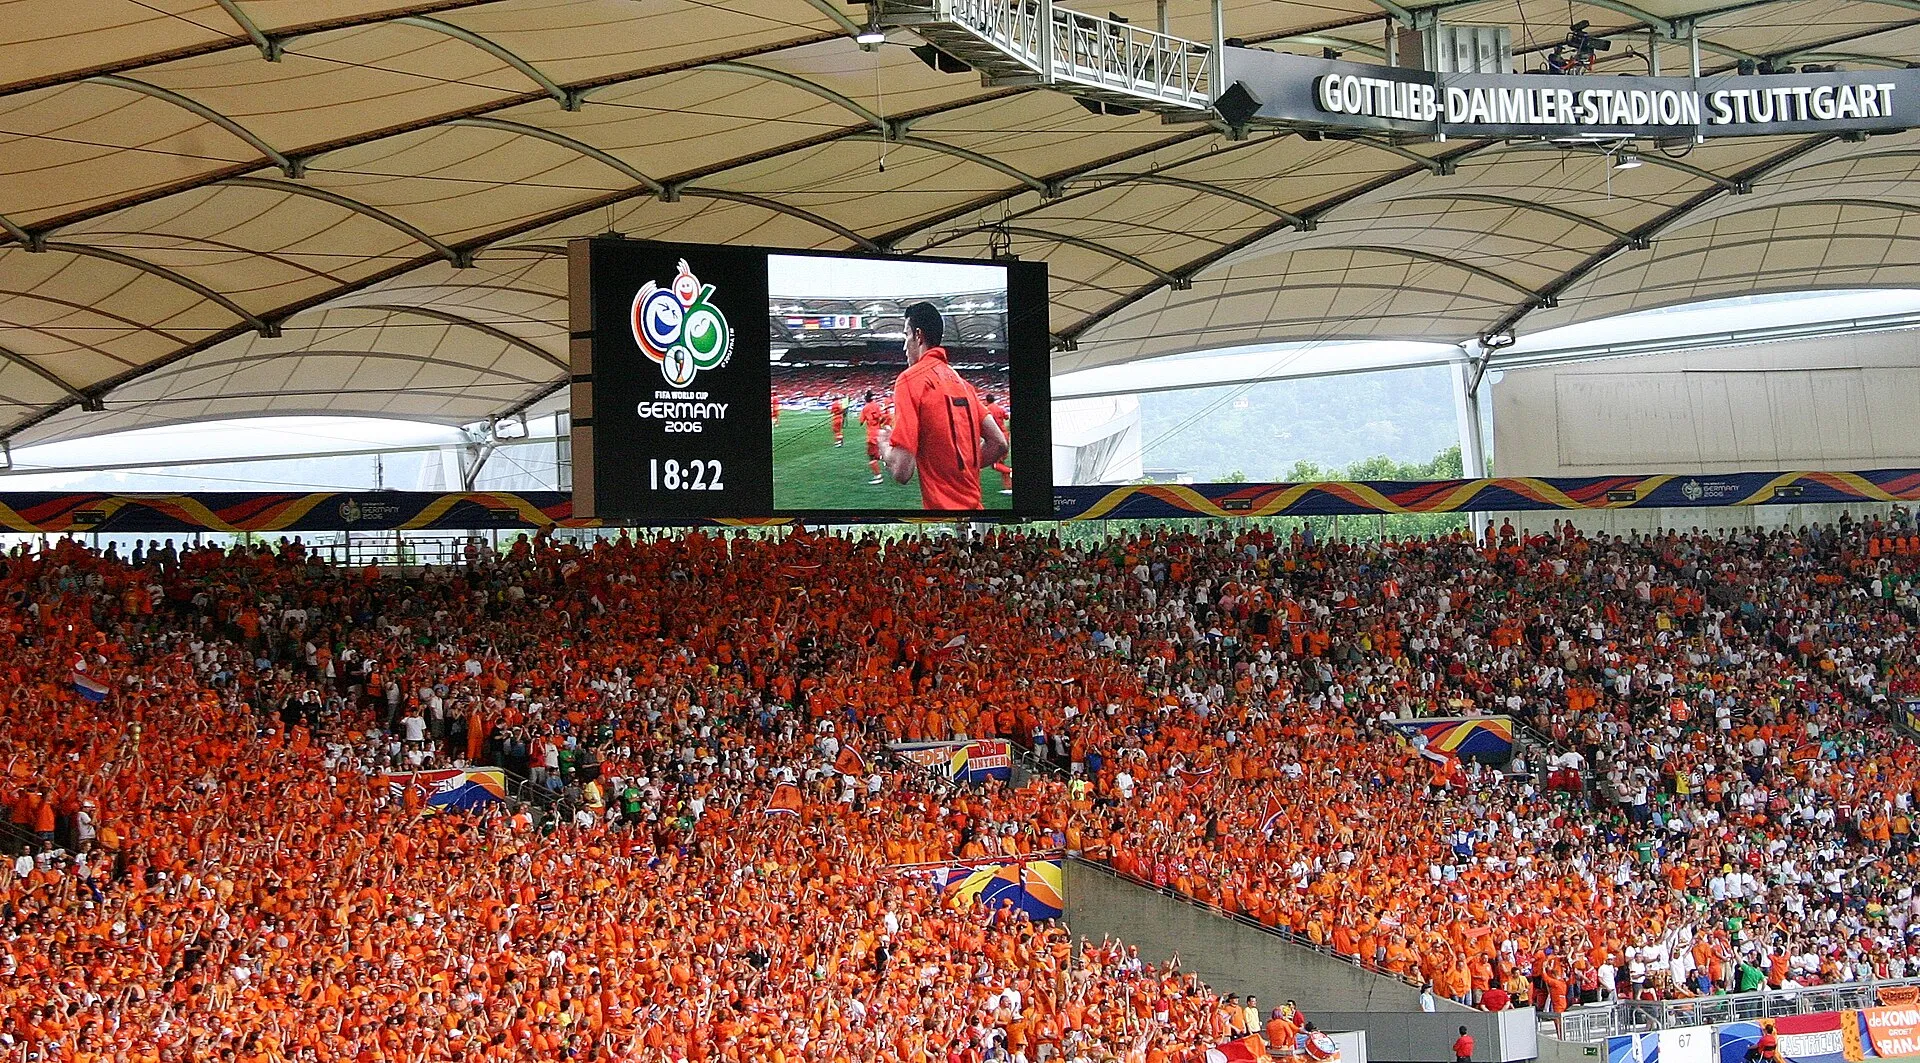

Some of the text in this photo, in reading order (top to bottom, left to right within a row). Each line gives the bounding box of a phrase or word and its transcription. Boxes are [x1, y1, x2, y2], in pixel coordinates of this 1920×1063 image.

[1319, 73, 1896, 126] GOTTLIEB-DAIMLER-STADION STUTTGART
[654, 390, 709, 400] FIFA WORLD CUP
[637, 401, 729, 420] GERMANY
[664, 420, 703, 433] 2006
[650, 458, 724, 491] 18:22
[1678, 1033, 1691, 1048] 67
